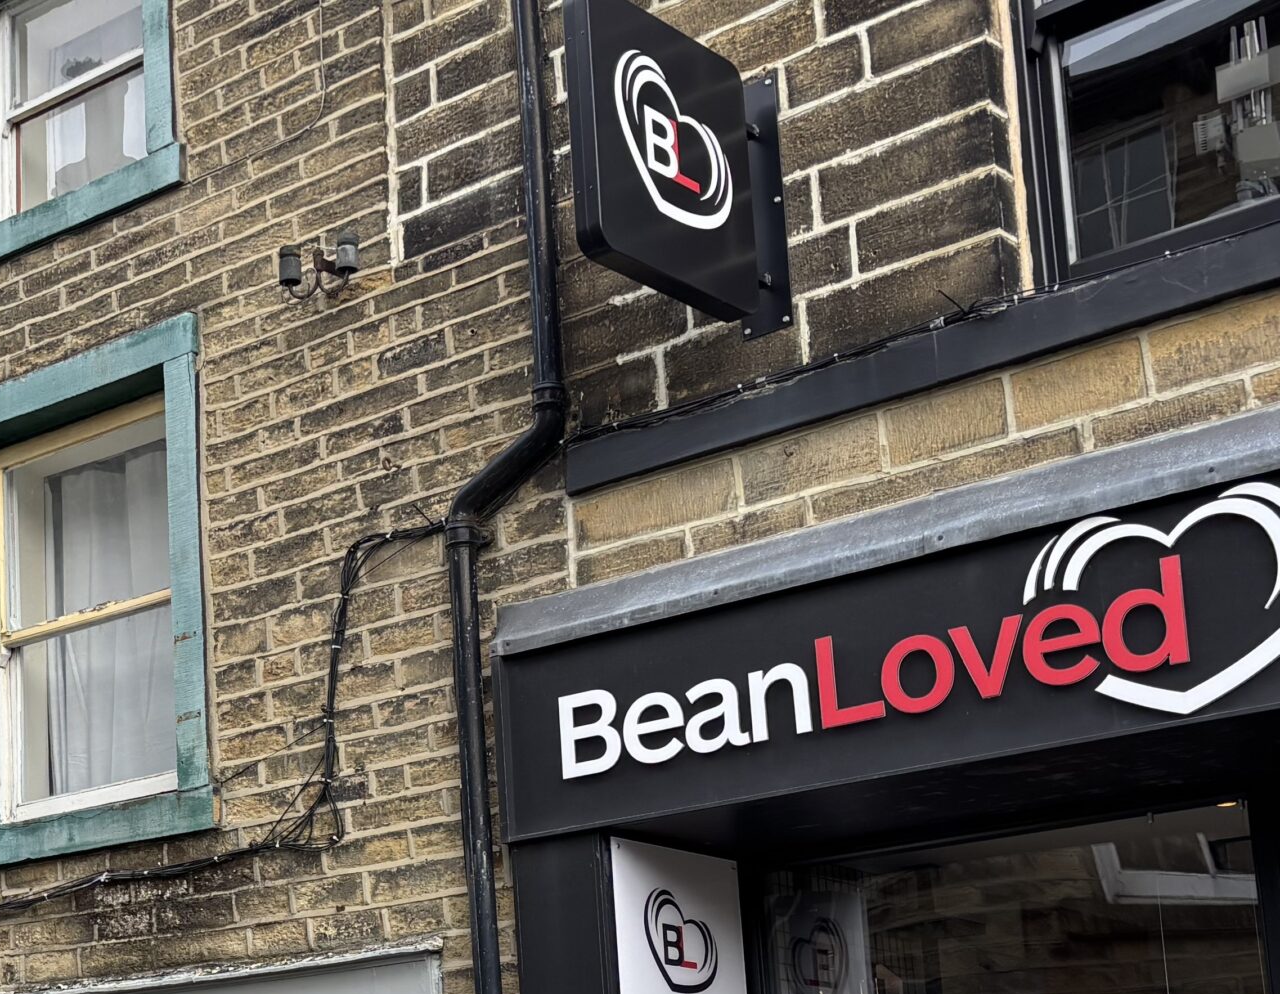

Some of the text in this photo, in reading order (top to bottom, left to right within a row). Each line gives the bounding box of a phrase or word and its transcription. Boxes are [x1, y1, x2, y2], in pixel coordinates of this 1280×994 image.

[644, 104, 701, 195] BL
[557, 554, 1191, 780] BeanLoved
[662, 923, 698, 969] BL
